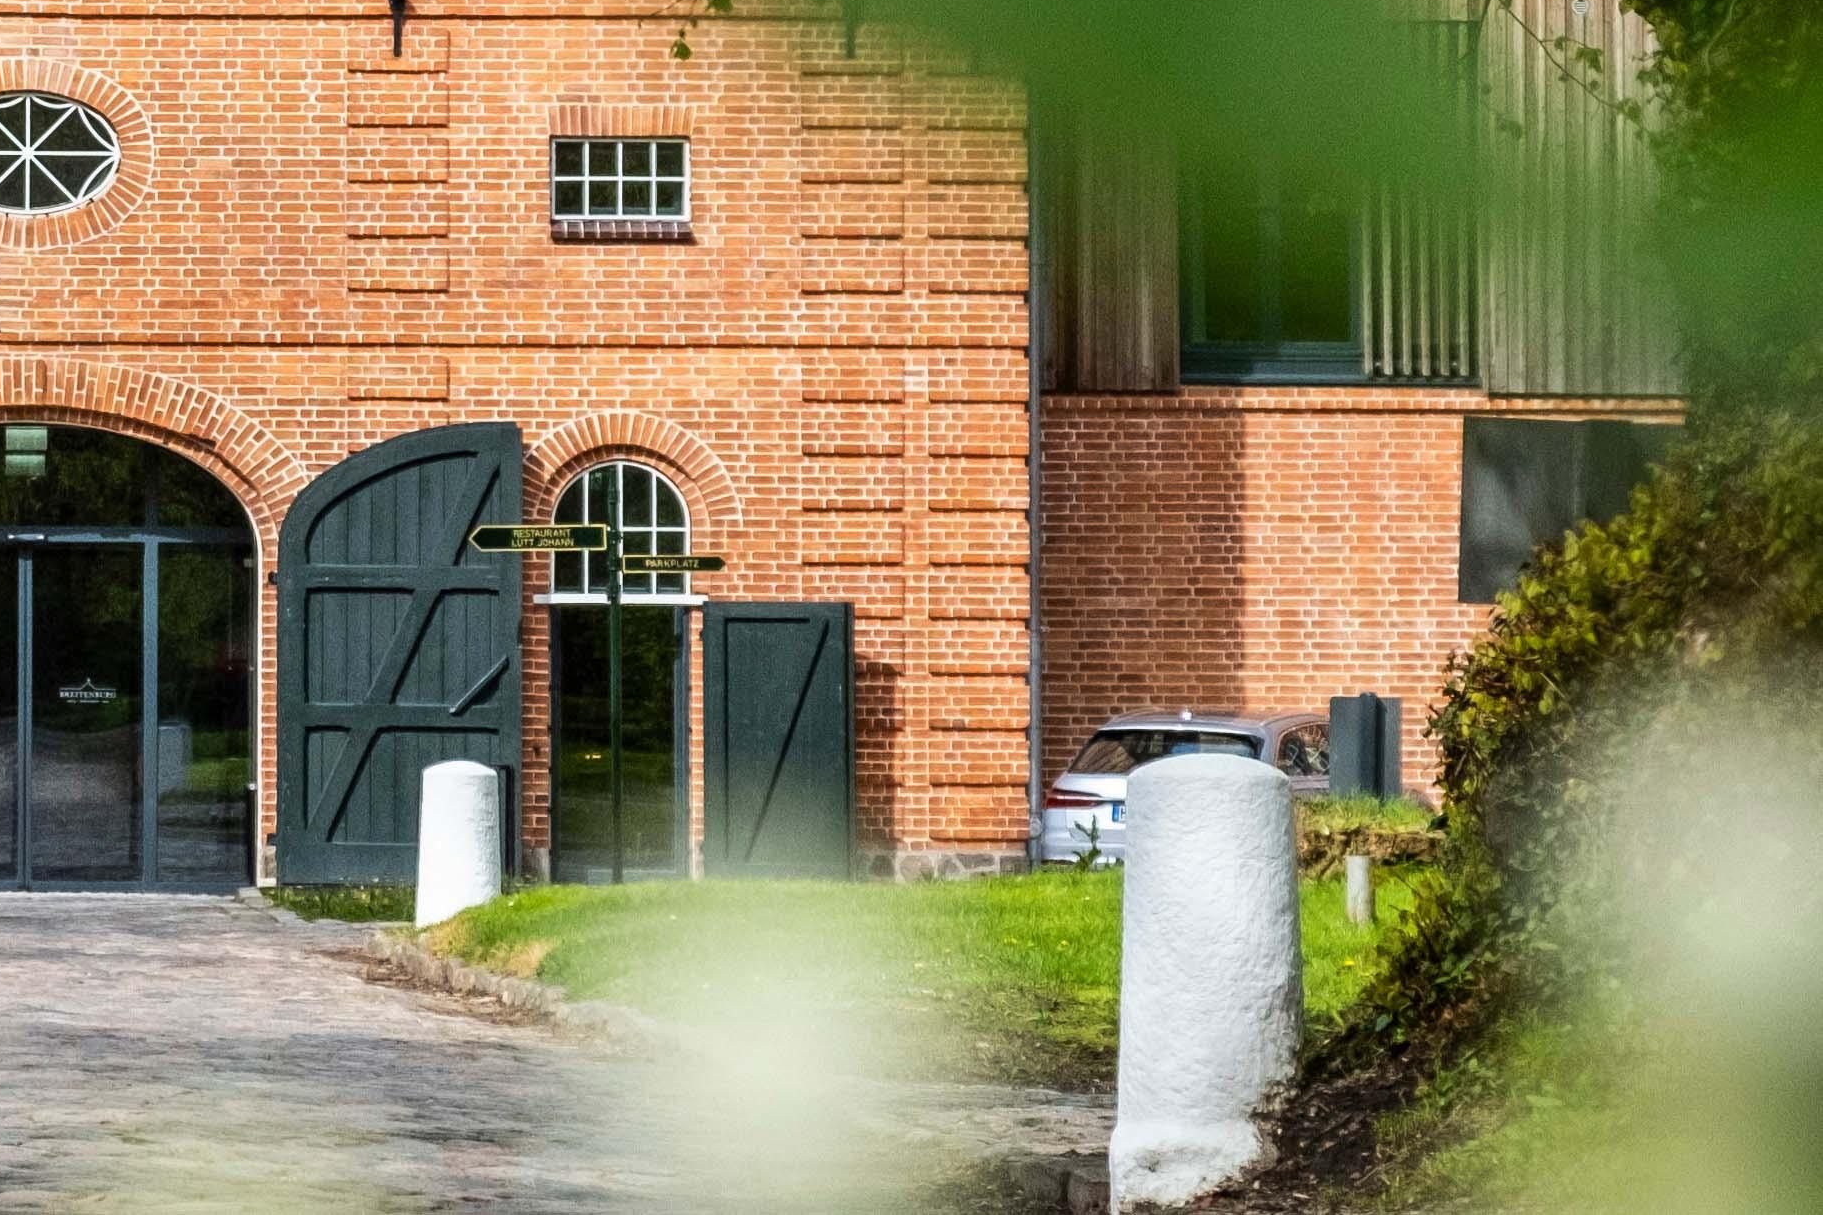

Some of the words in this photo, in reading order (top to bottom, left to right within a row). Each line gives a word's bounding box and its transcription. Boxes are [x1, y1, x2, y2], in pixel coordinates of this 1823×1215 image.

[513, 529, 571, 537] RESTAURANT
[537, 538, 574, 547] JOHANN
[645, 559, 700, 568] PARKPLATZ
